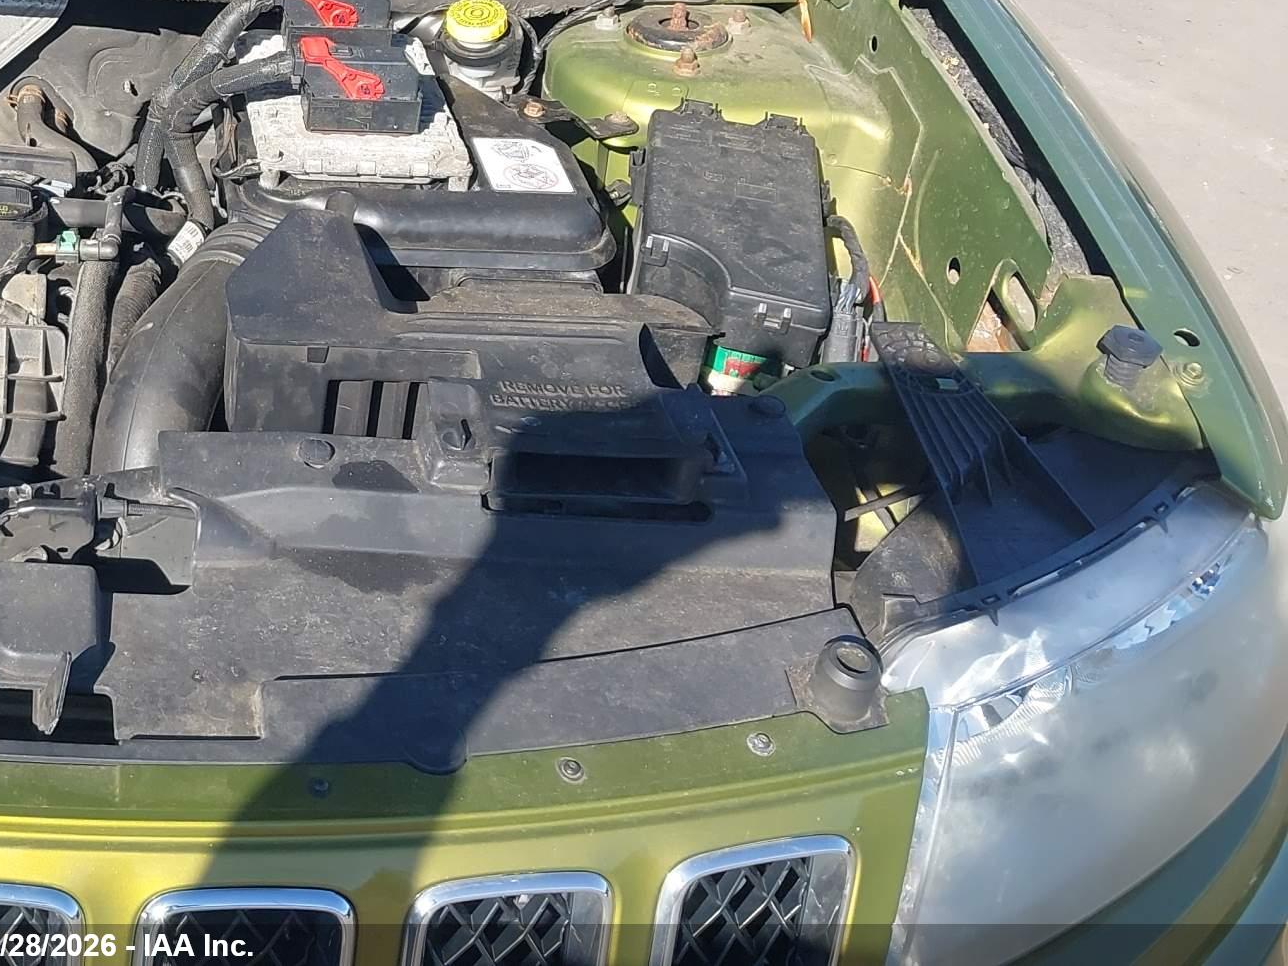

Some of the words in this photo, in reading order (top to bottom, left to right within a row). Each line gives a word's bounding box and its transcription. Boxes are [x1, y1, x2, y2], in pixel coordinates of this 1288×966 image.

[499, 380, 585, 398] REMOVE
[585, 383, 631, 398] FOR
[489, 393, 574, 412] BATTERY
